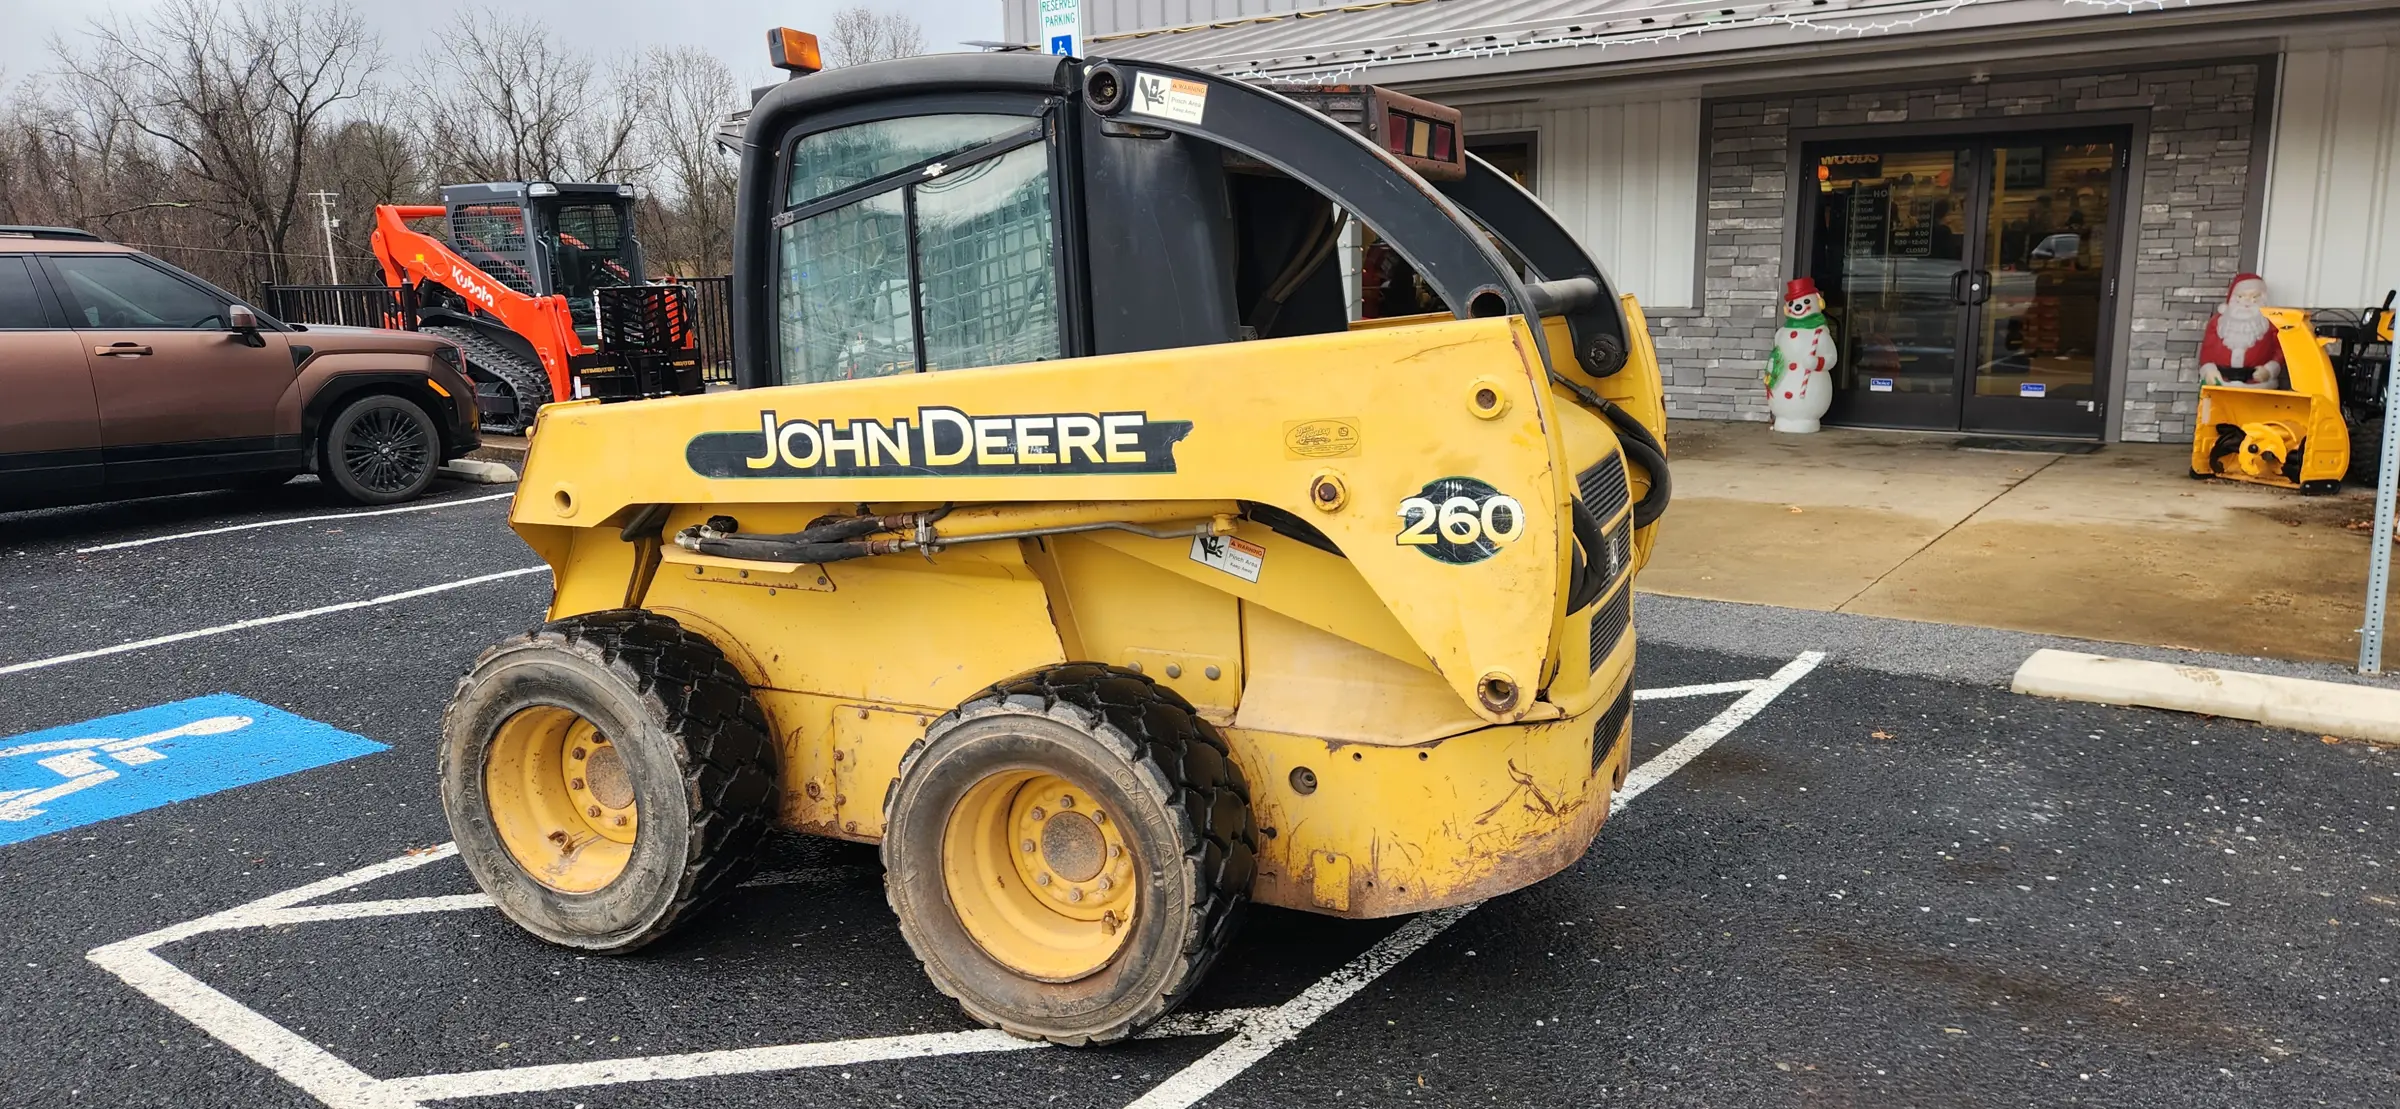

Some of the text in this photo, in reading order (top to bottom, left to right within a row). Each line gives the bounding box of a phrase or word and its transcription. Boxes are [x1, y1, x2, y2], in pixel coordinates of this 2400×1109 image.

[1040, 0, 1077, 12] RESERVED
[1045, 12, 1076, 28] PARKING
[1178, 83, 1205, 94] WARNING
[1171, 96, 1202, 108] Pinch Area
[1820, 154, 1879, 165] WOODS
[452, 265, 494, 308] Kubota
[746, 409, 1147, 469] JOHN DEERE
[1396, 494, 1525, 545] 260
[1237, 543, 1263, 556] WARNING
[1229, 552, 1258, 568] Pinch Area
